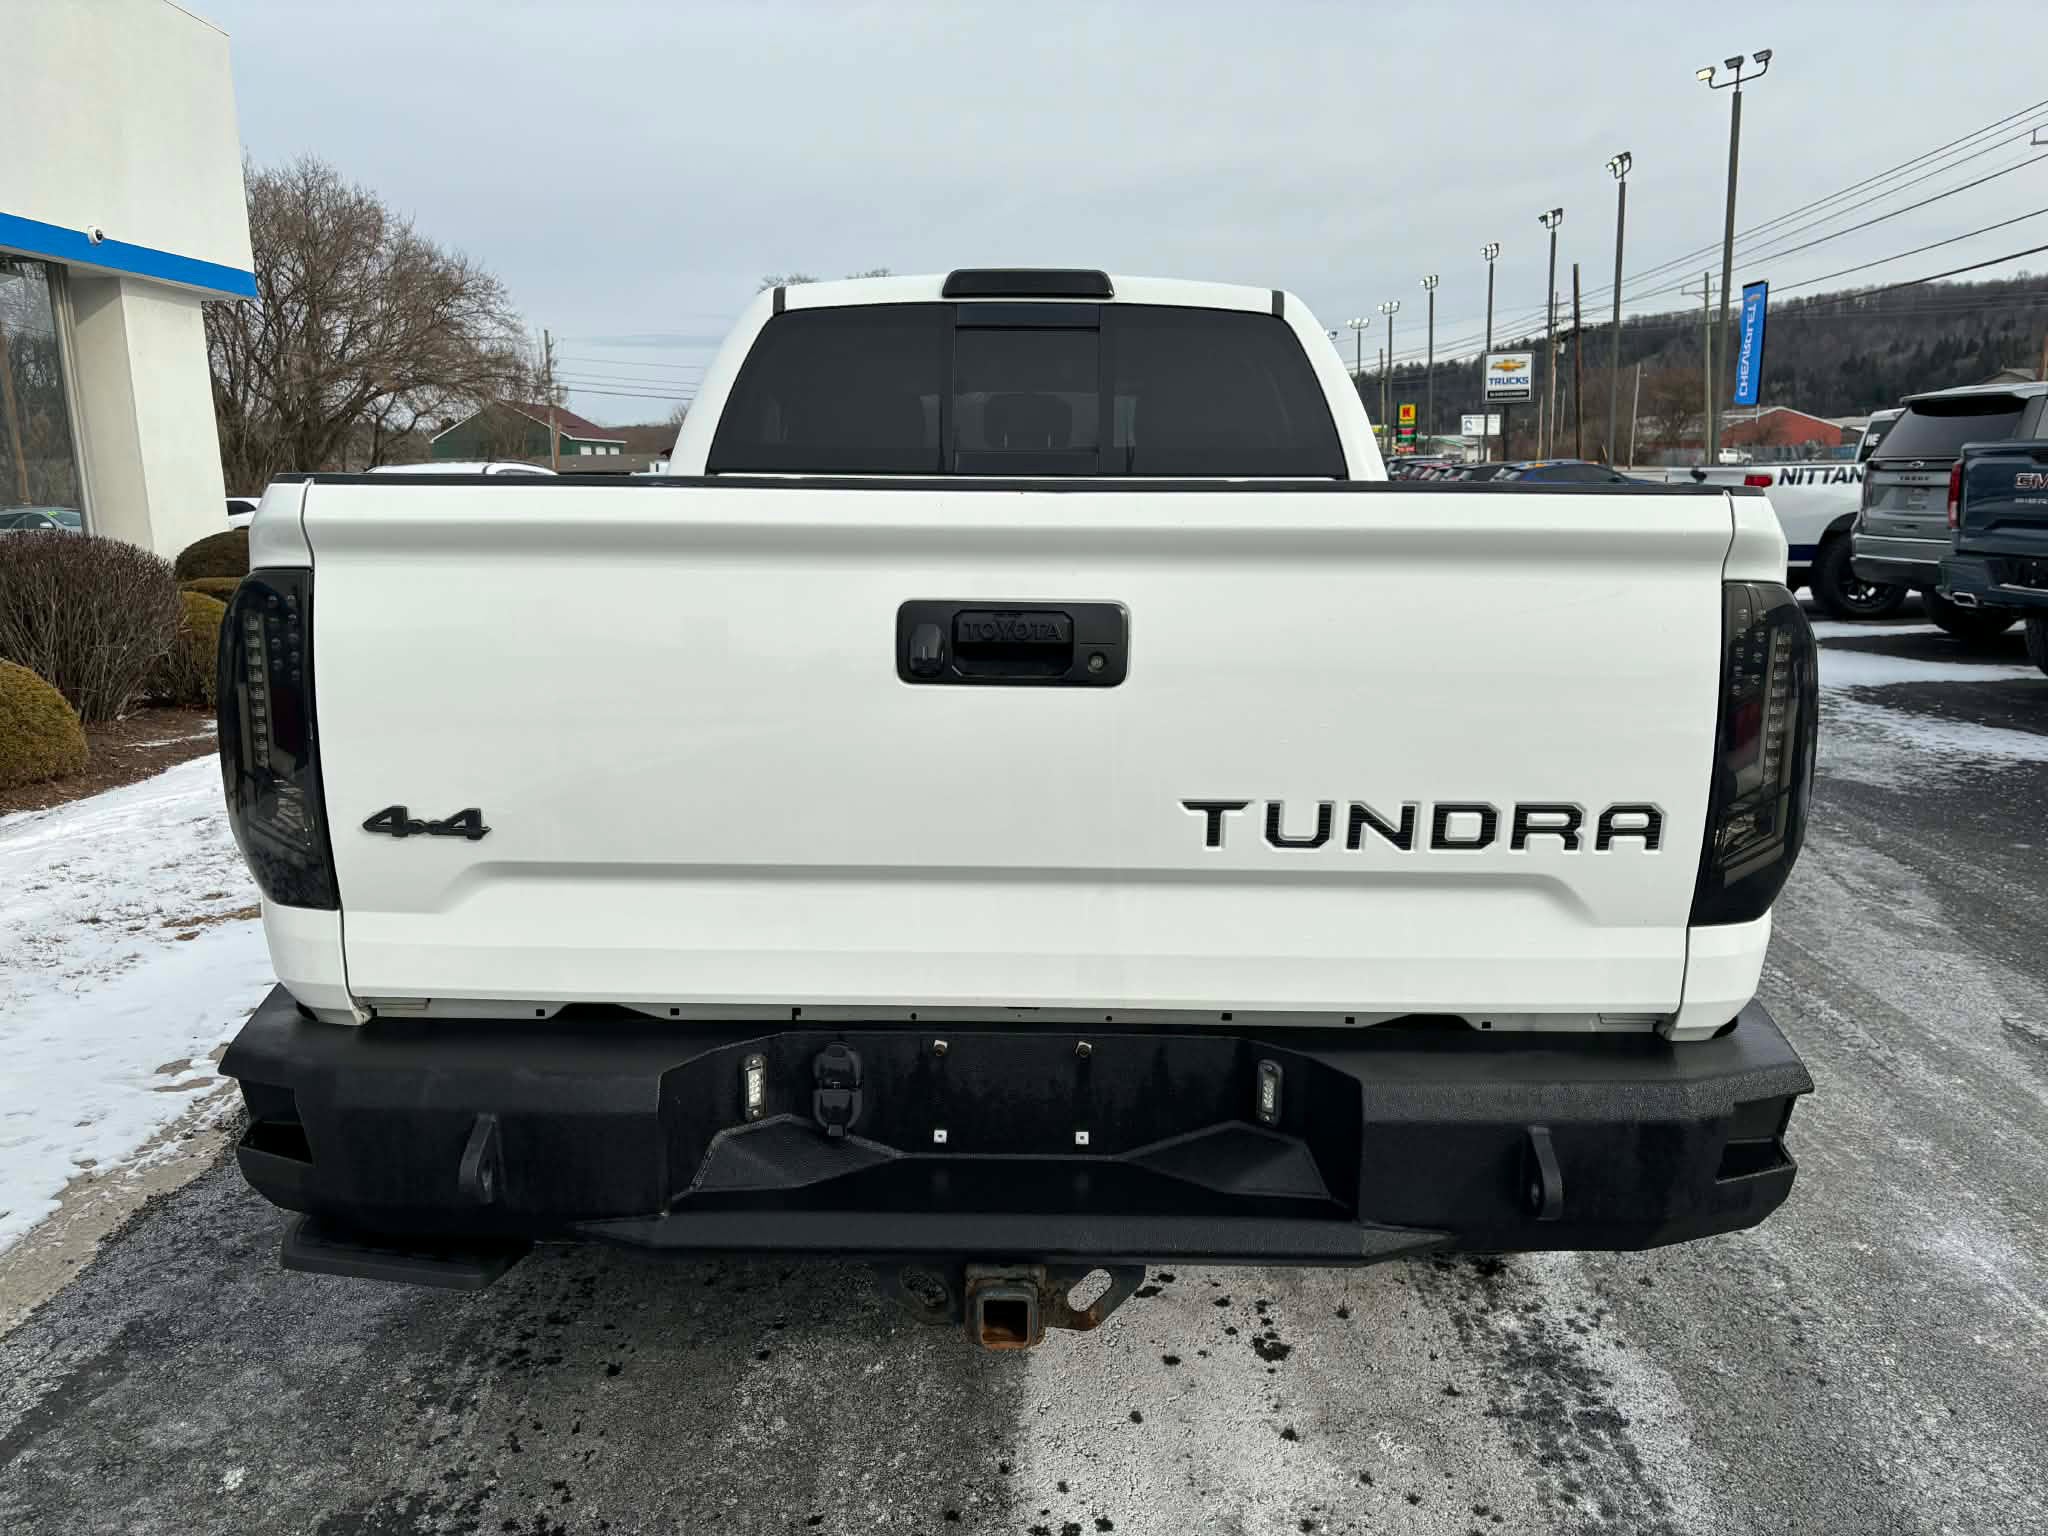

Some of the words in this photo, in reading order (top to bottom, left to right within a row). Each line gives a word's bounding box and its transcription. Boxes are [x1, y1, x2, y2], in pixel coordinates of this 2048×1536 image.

[1488, 377, 1528, 385] TRUCKS
[1778, 467, 1864, 486] NITTAN
[963, 623, 1064, 641] TOYOTA
[1179, 800, 1665, 852] TUNDRA
